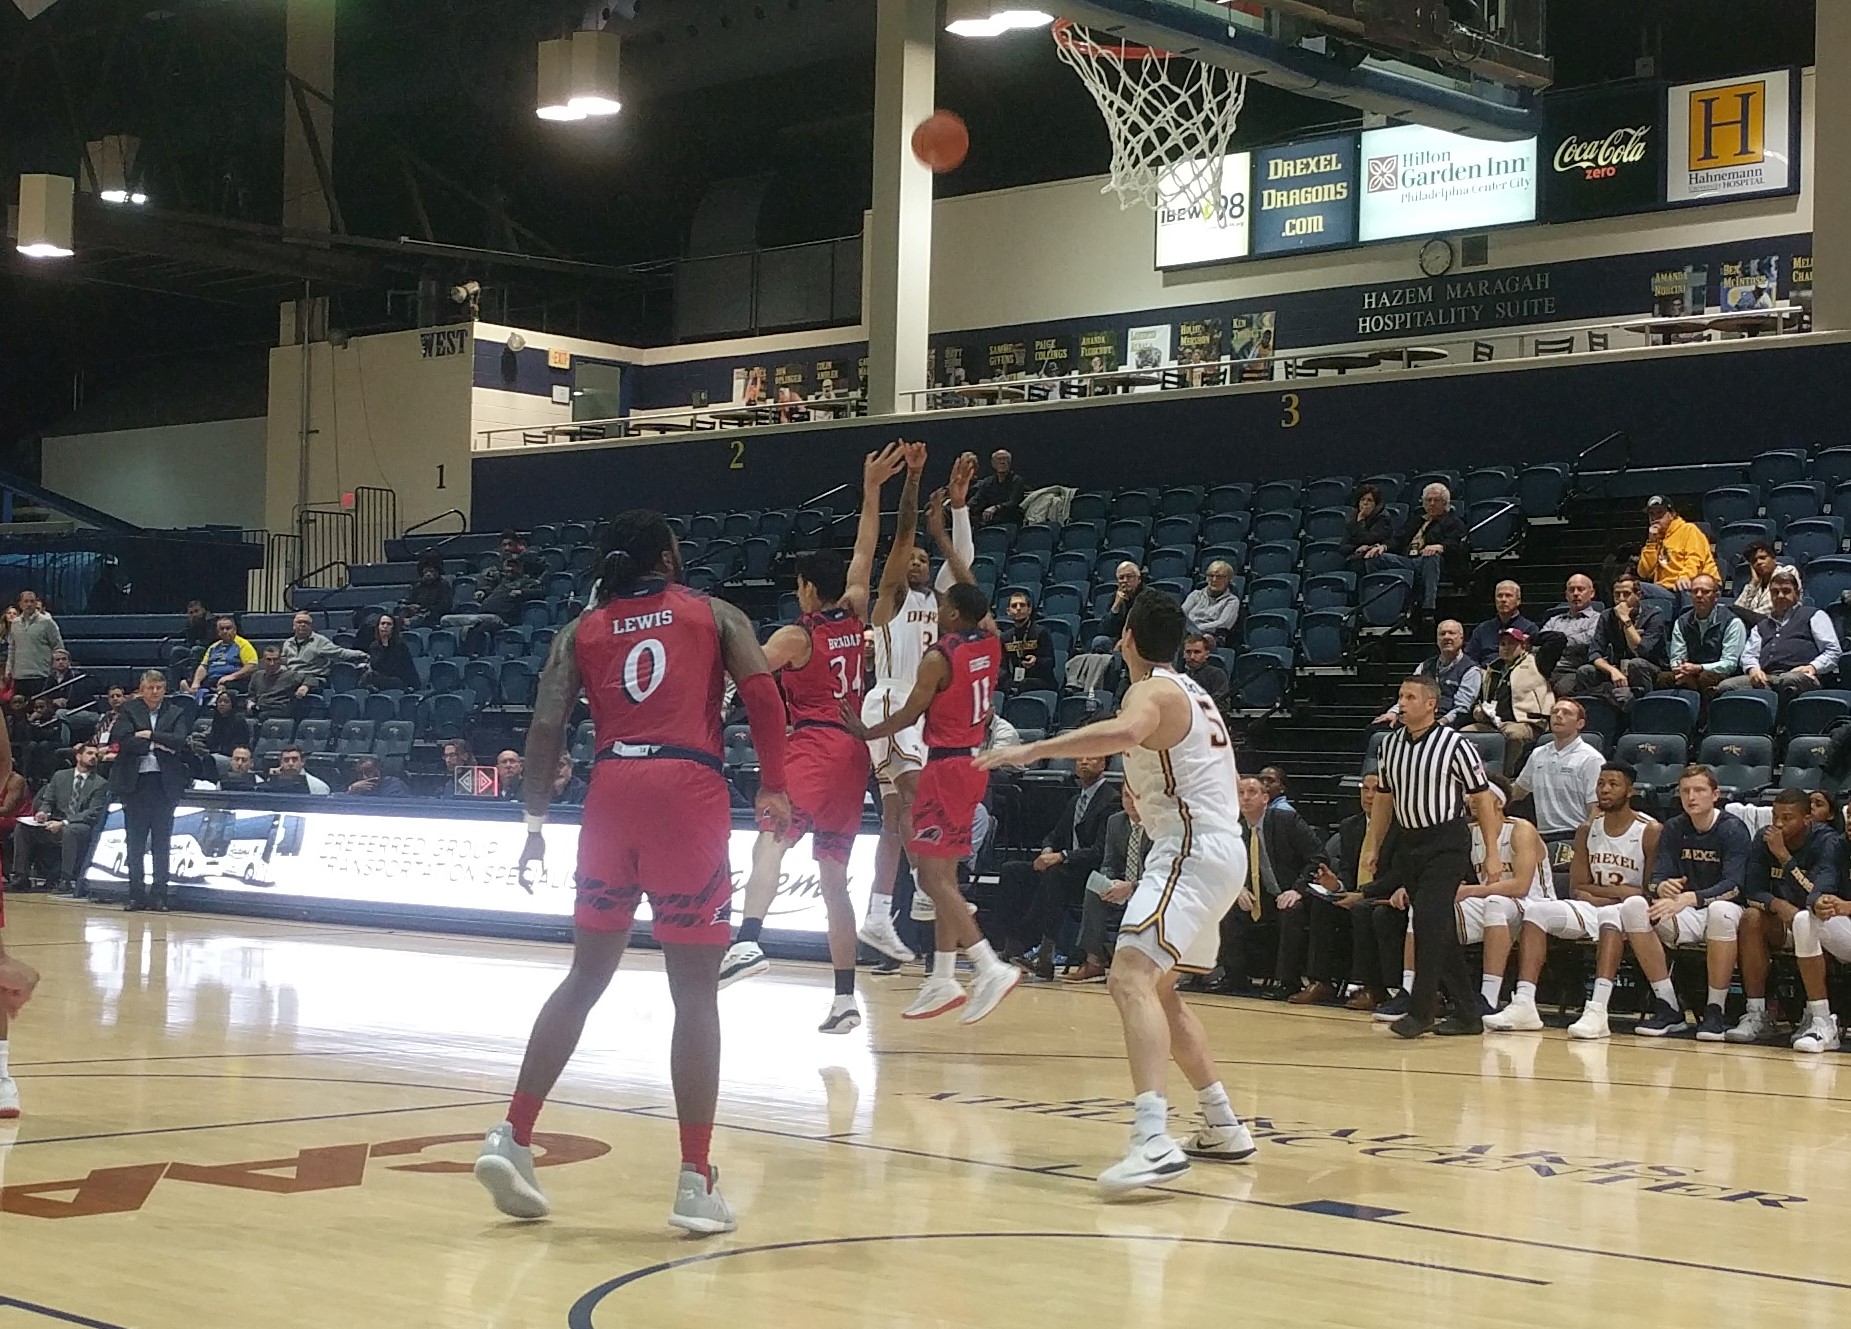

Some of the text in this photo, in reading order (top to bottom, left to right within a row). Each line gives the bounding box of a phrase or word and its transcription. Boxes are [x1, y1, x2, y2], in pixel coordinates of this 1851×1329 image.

[1696, 91, 1757, 162] H
[1402, 150, 1452, 168] Hilton
[1553, 125, 1652, 172] Coca-Cola
[1267, 153, 1342, 180] DREXEL
[1401, 156, 1527, 189] Garden Inn
[1584, 166, 1617, 180] zero
[1688, 168, 1763, 186] Hahnemann
[1261, 182, 1348, 210] DRAGONS
[1401, 177, 1532, 204] Philadelphia Center City
[1722, 177, 1765, 190] HOSPITAL
[1161, 205, 1202, 223] IBEW
[1362, 272, 1551, 310] HAZEM MARAGAH
[1357, 296, 1556, 334] HOSPITALITY SUITE
[420, 329, 469, 358] WEST
[1281, 393, 1300, 428] 3
[730, 440, 745, 469] 2
[436, 463, 447, 489] 1
[612, 609, 673, 635] LEWIS
[623, 638, 667, 703] 0
[829, 653, 862, 699] 34
[1196, 698, 1228, 747] 5
[324, 833, 499, 859] PREFERRED GROUP
[1589, 852, 1640, 872] DREXEL
[1358, 1146, 1810, 1209] CENTER
